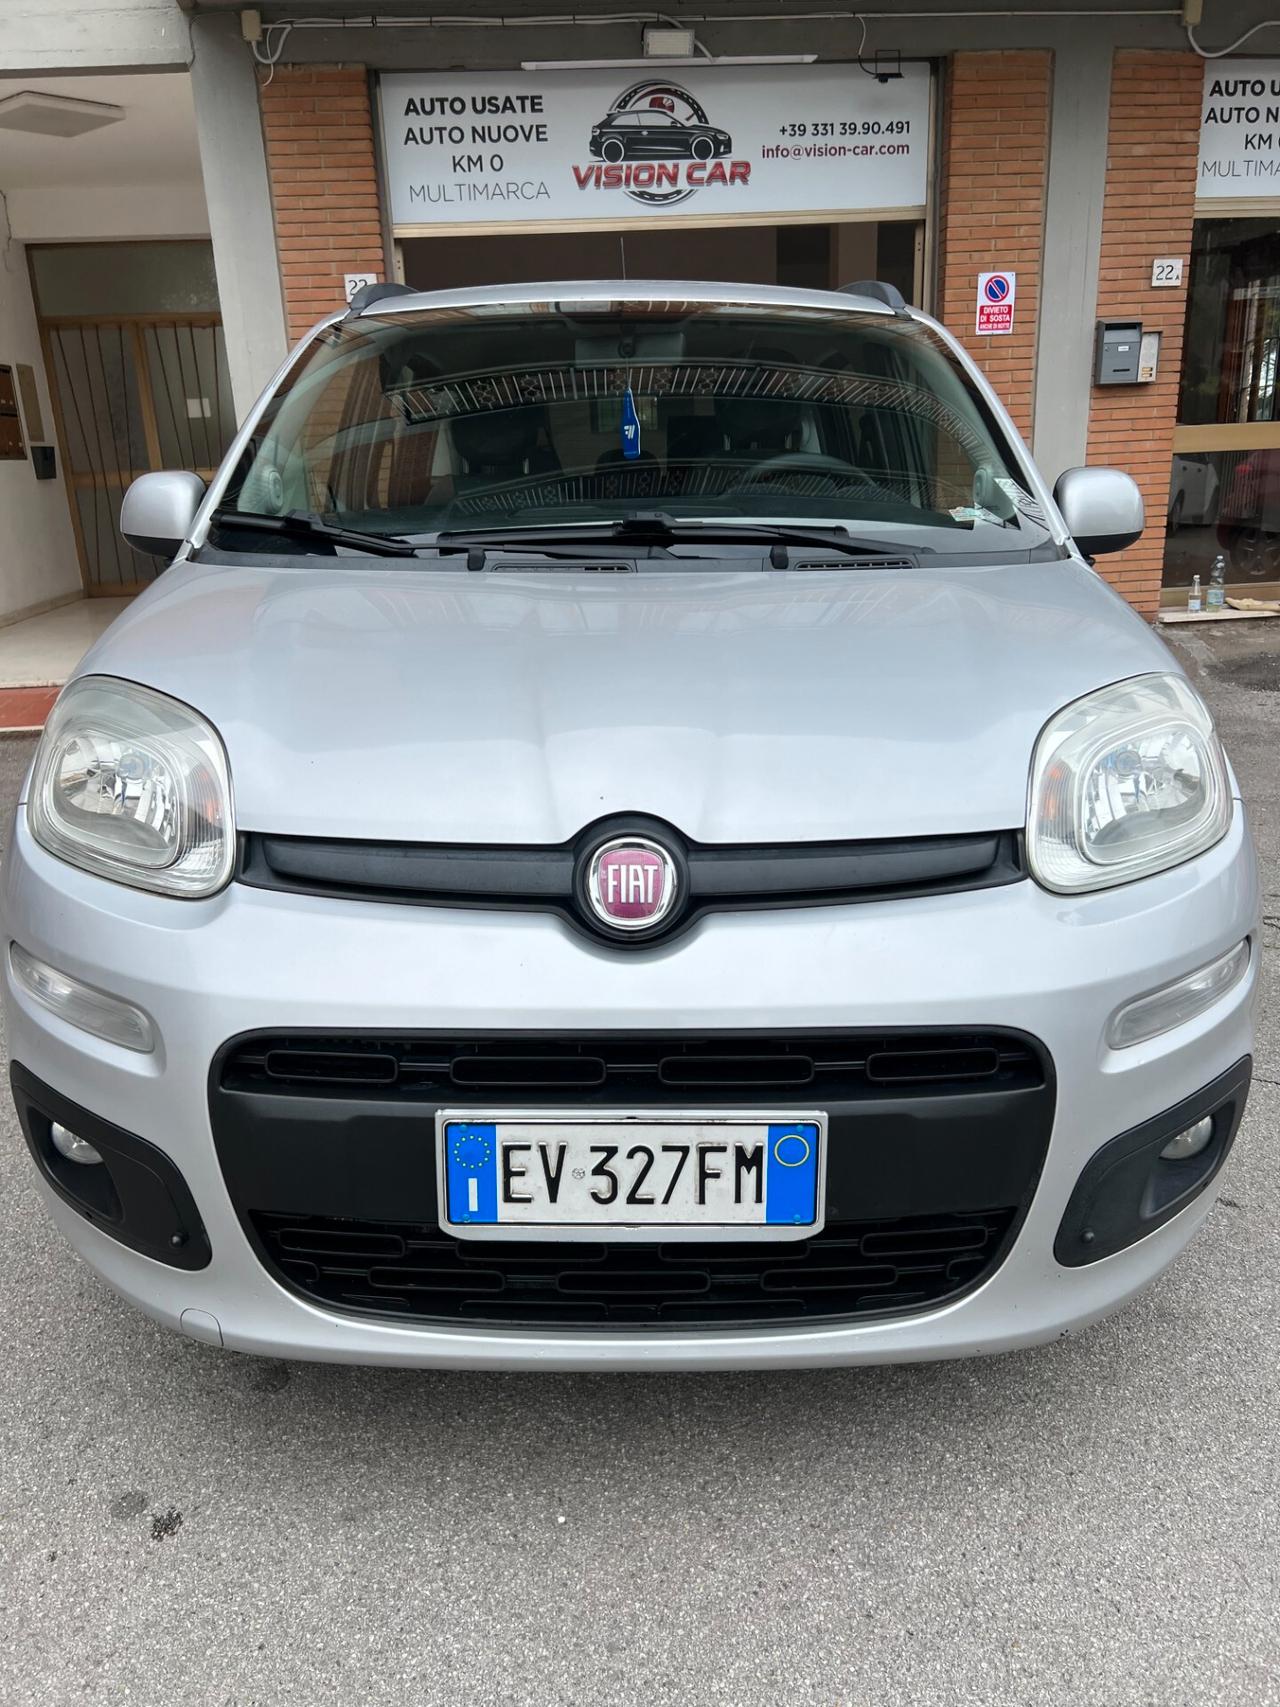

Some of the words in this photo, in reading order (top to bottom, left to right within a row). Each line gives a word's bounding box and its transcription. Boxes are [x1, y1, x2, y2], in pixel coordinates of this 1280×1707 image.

[1209, 80, 1266, 97] AUTO
[404, 97, 466, 116] AUTO
[471, 95, 544, 114] USATE
[1204, 107, 1260, 124] AUTO
[404, 126, 465, 145] AUTO
[472, 124, 548, 144] NUOVE
[779, 124, 807, 137] +39
[811, 122, 834, 136] 331
[839, 121, 910, 136] 39.90.491
[761, 143, 910, 160] info@vision-car.com
[1244, 133, 1272, 150] KM
[452, 155, 483, 173] KM
[490, 154, 504, 172] 0
[572, 162, 679, 190] VISION
[686, 160, 752, 187] CAR
[409, 181, 551, 203] MULTIMARCA
[607, 864, 658, 904] FIAT
[589, 1141, 764, 1205] 327FM
